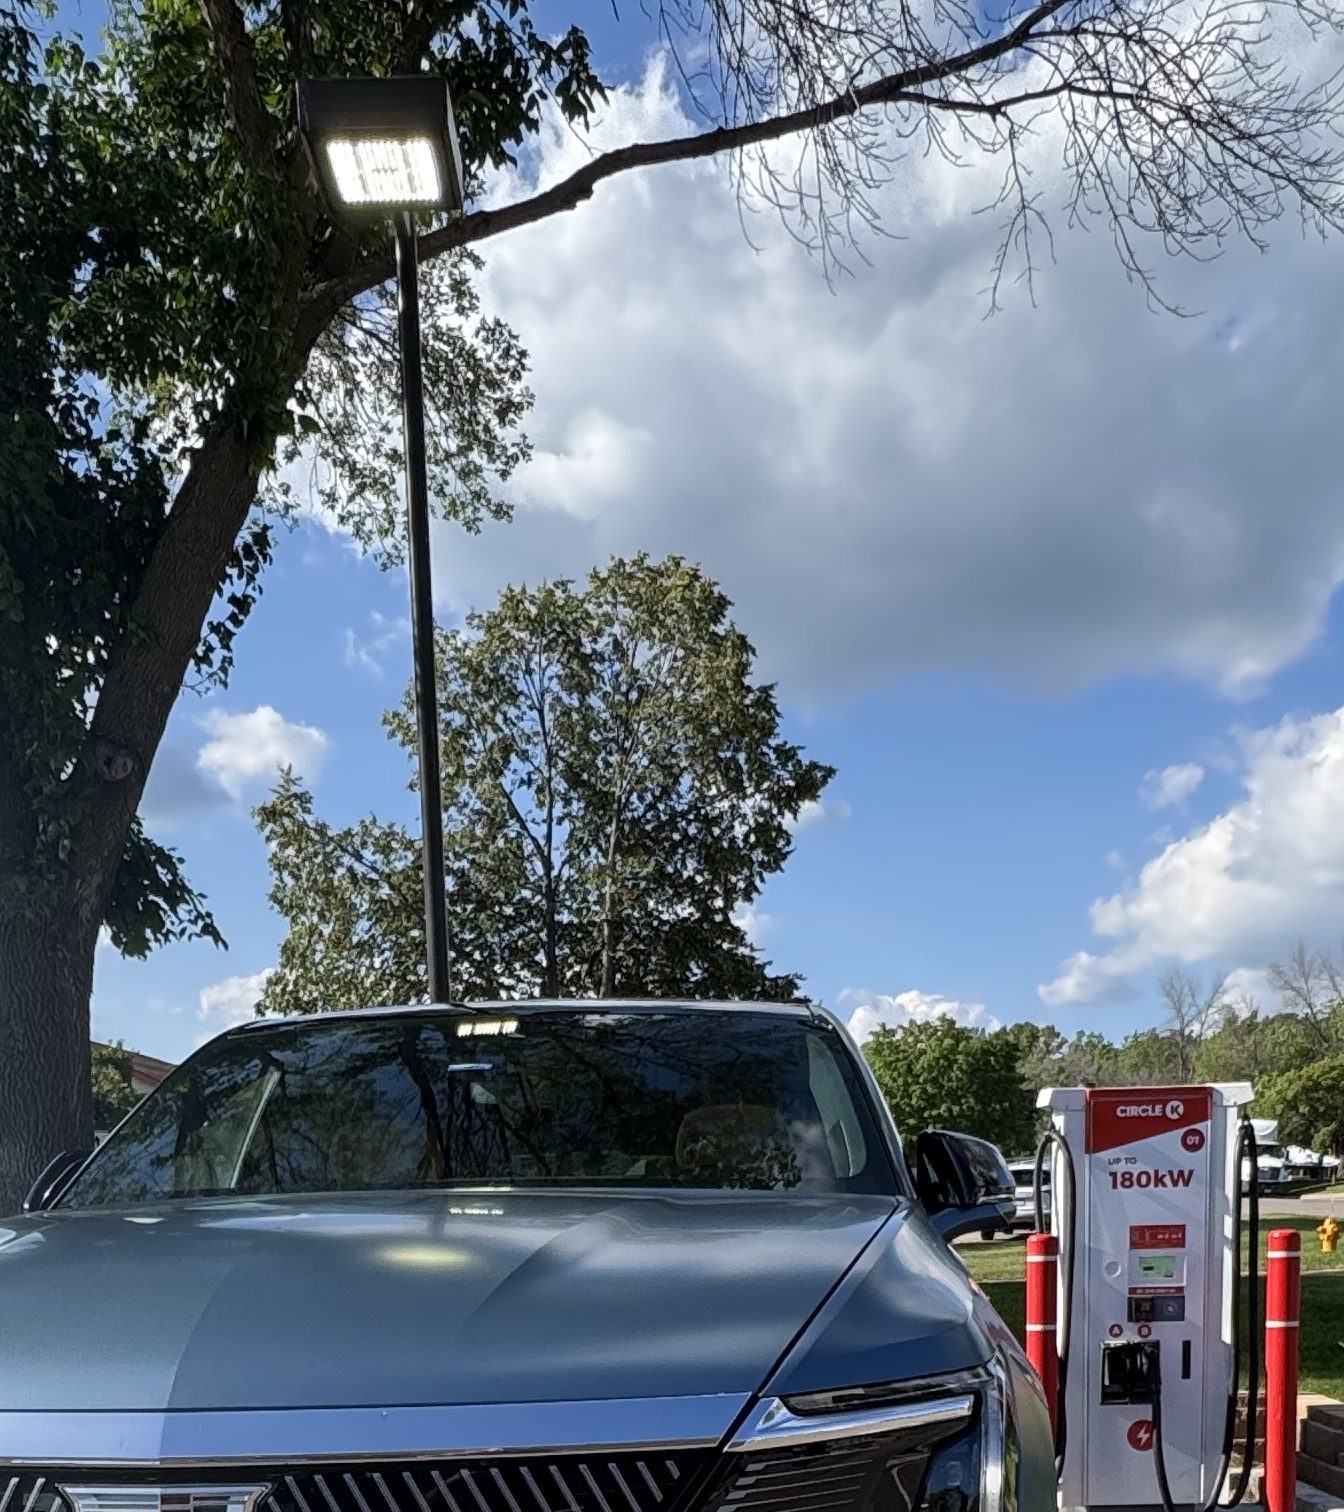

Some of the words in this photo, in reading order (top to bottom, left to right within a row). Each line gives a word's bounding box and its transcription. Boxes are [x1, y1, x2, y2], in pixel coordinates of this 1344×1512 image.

[1116, 1105, 1163, 1117] CIRCLE
[1107, 1157, 1122, 1165] UP
[1124, 1156, 1137, 1165] TO
[1109, 1168, 1195, 1189] 180kW
